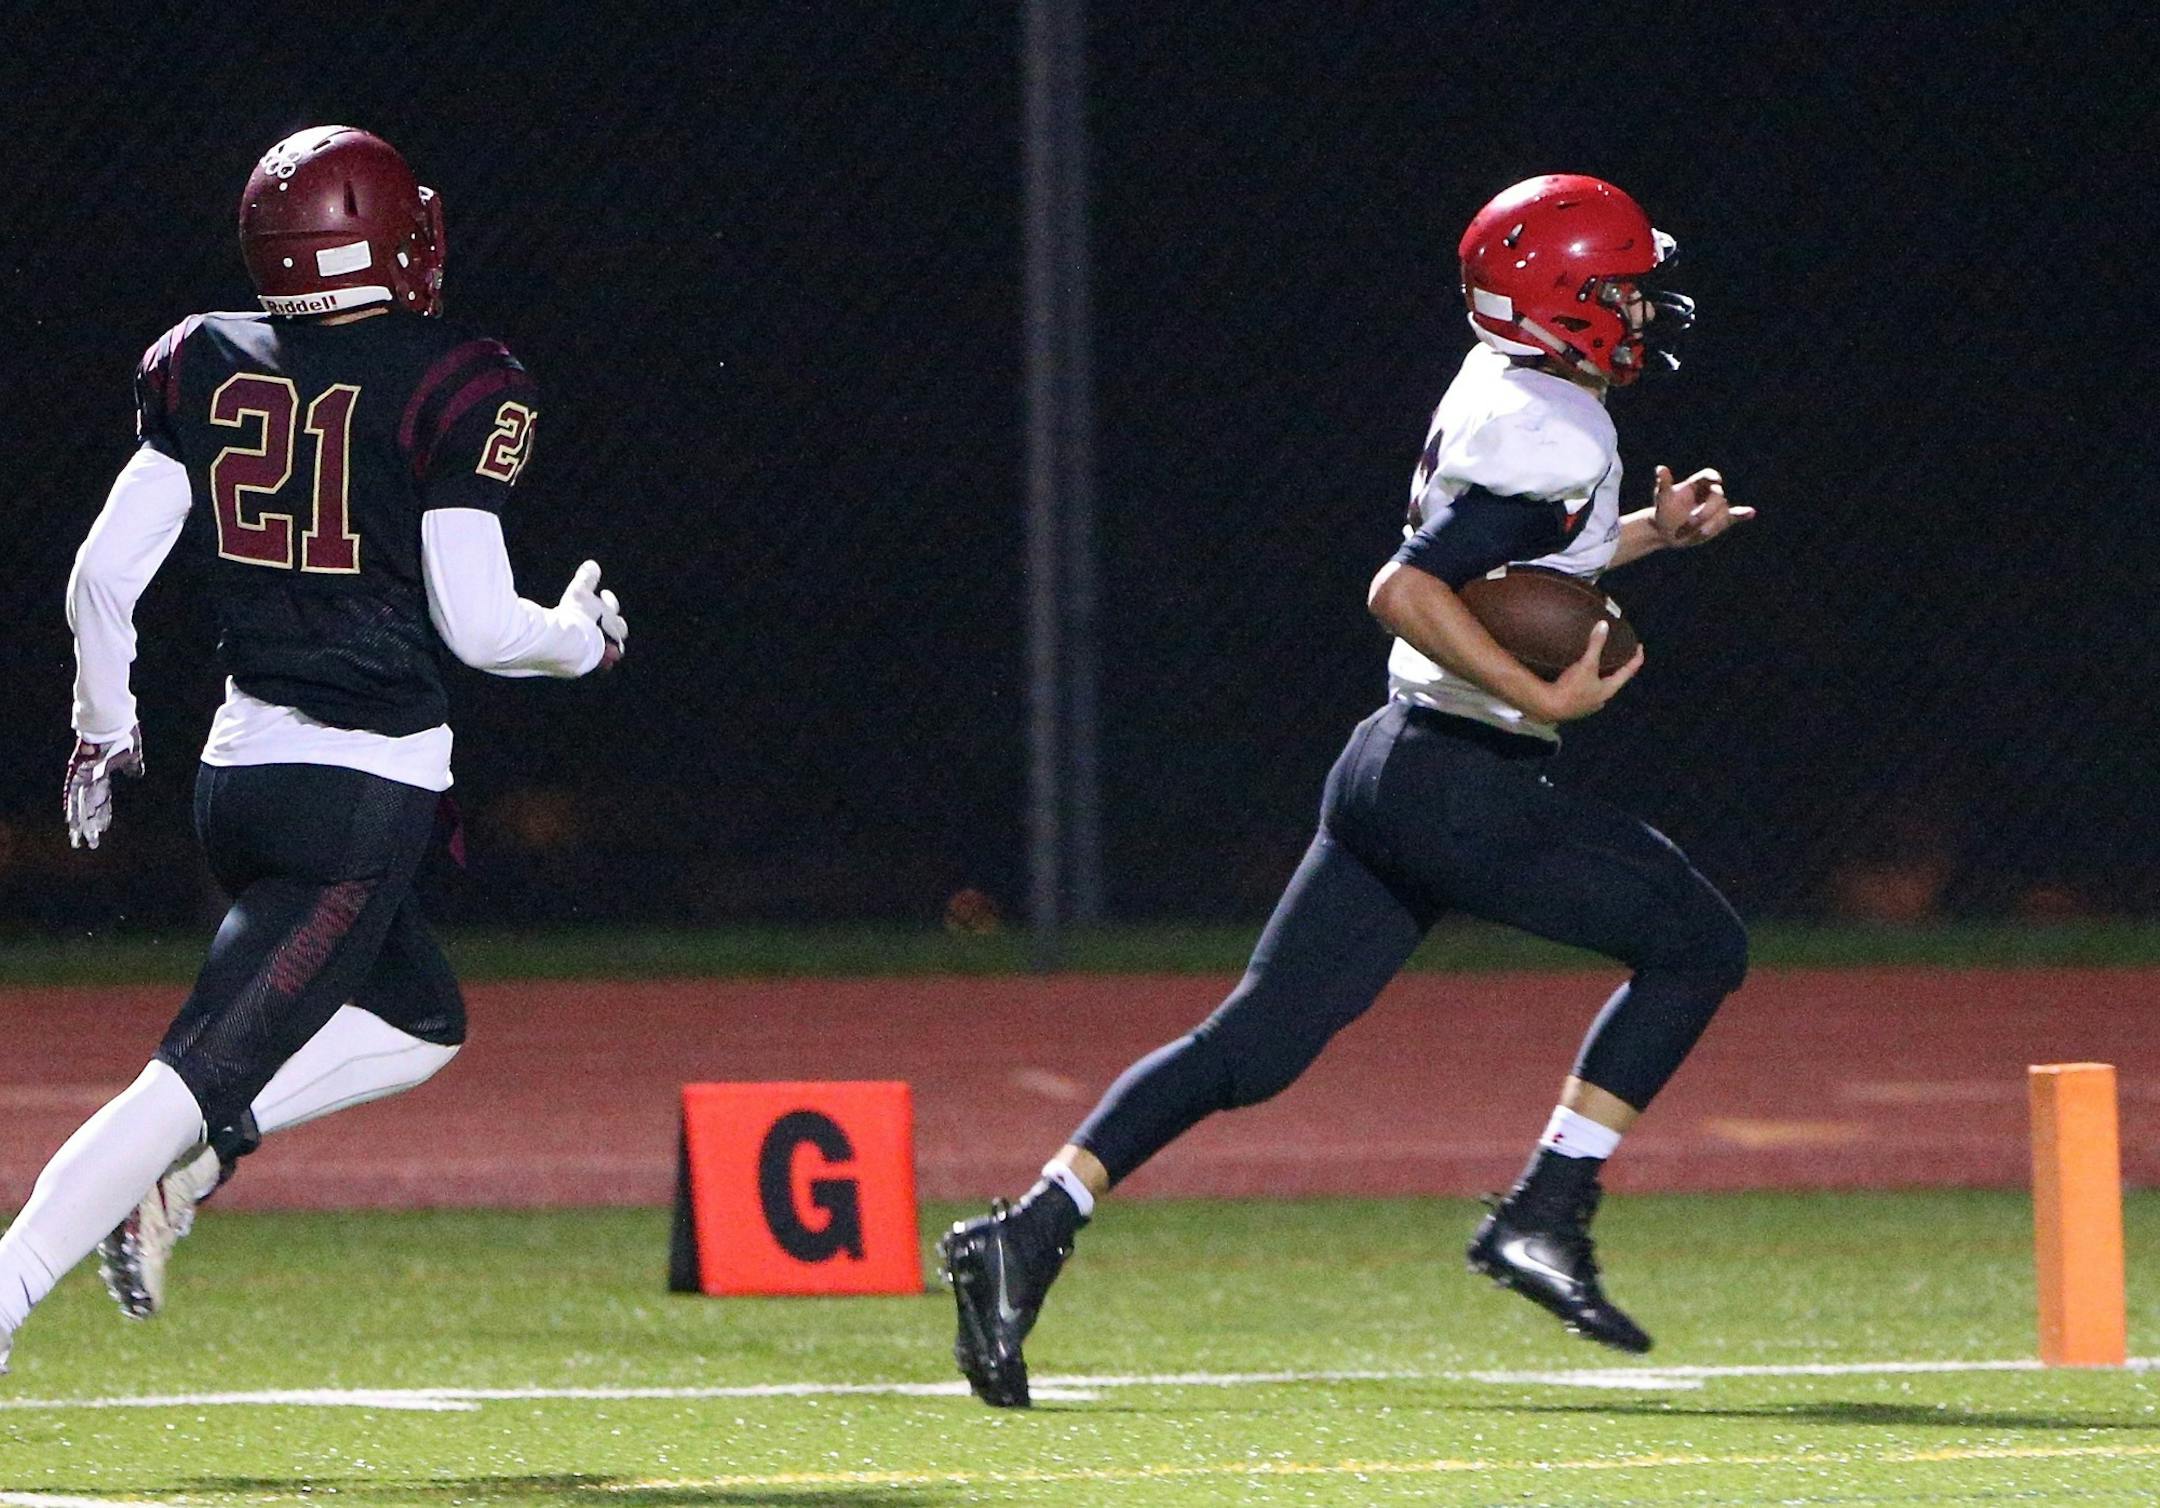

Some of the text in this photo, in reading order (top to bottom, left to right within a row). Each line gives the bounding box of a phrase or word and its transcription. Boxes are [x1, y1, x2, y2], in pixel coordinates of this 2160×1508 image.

[265, 295, 338, 314] Riddell
[210, 372, 362, 575] 21
[758, 1109, 866, 1263] G
